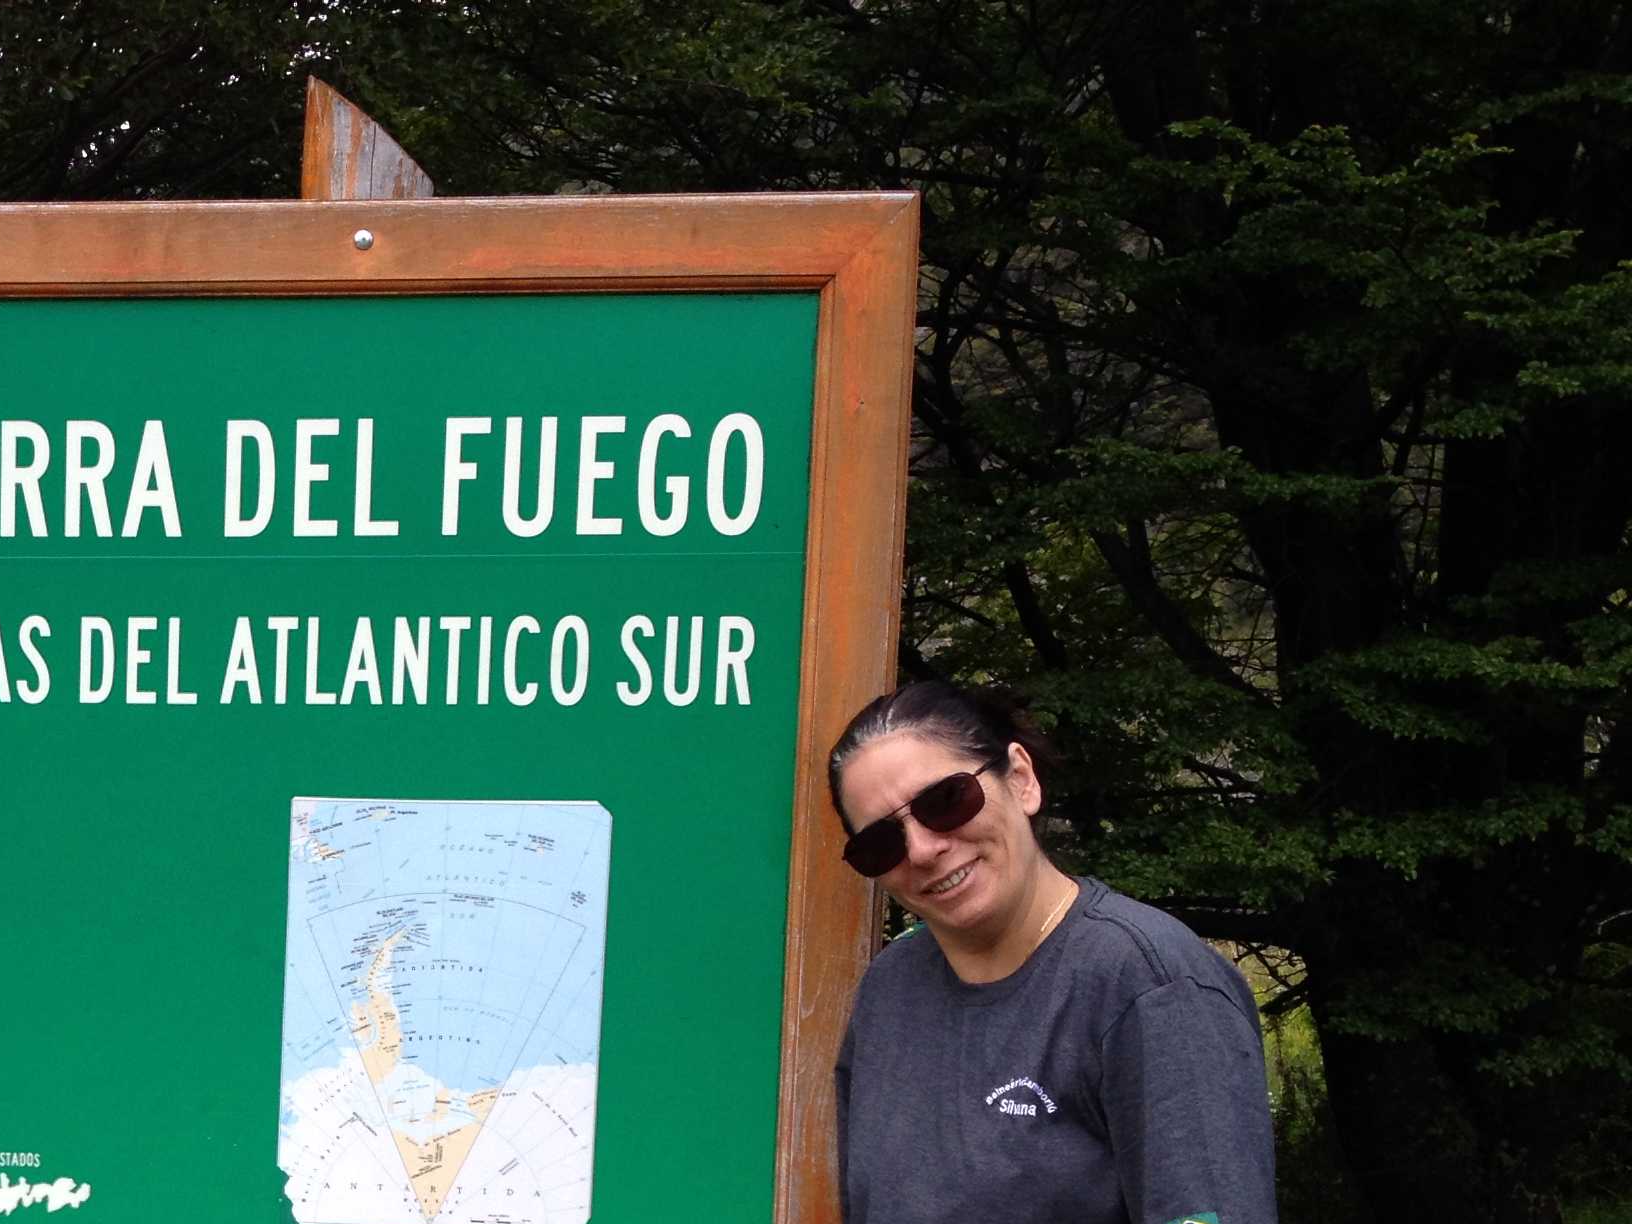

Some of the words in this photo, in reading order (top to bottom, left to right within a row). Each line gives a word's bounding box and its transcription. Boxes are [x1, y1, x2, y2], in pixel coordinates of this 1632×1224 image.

[223, 417, 400, 538] DEL
[441, 412, 764, 538] FUEGO
[79, 616, 198, 705] DEL
[219, 614, 590, 707] ATLANTICO
[616, 614, 756, 707] SUR
